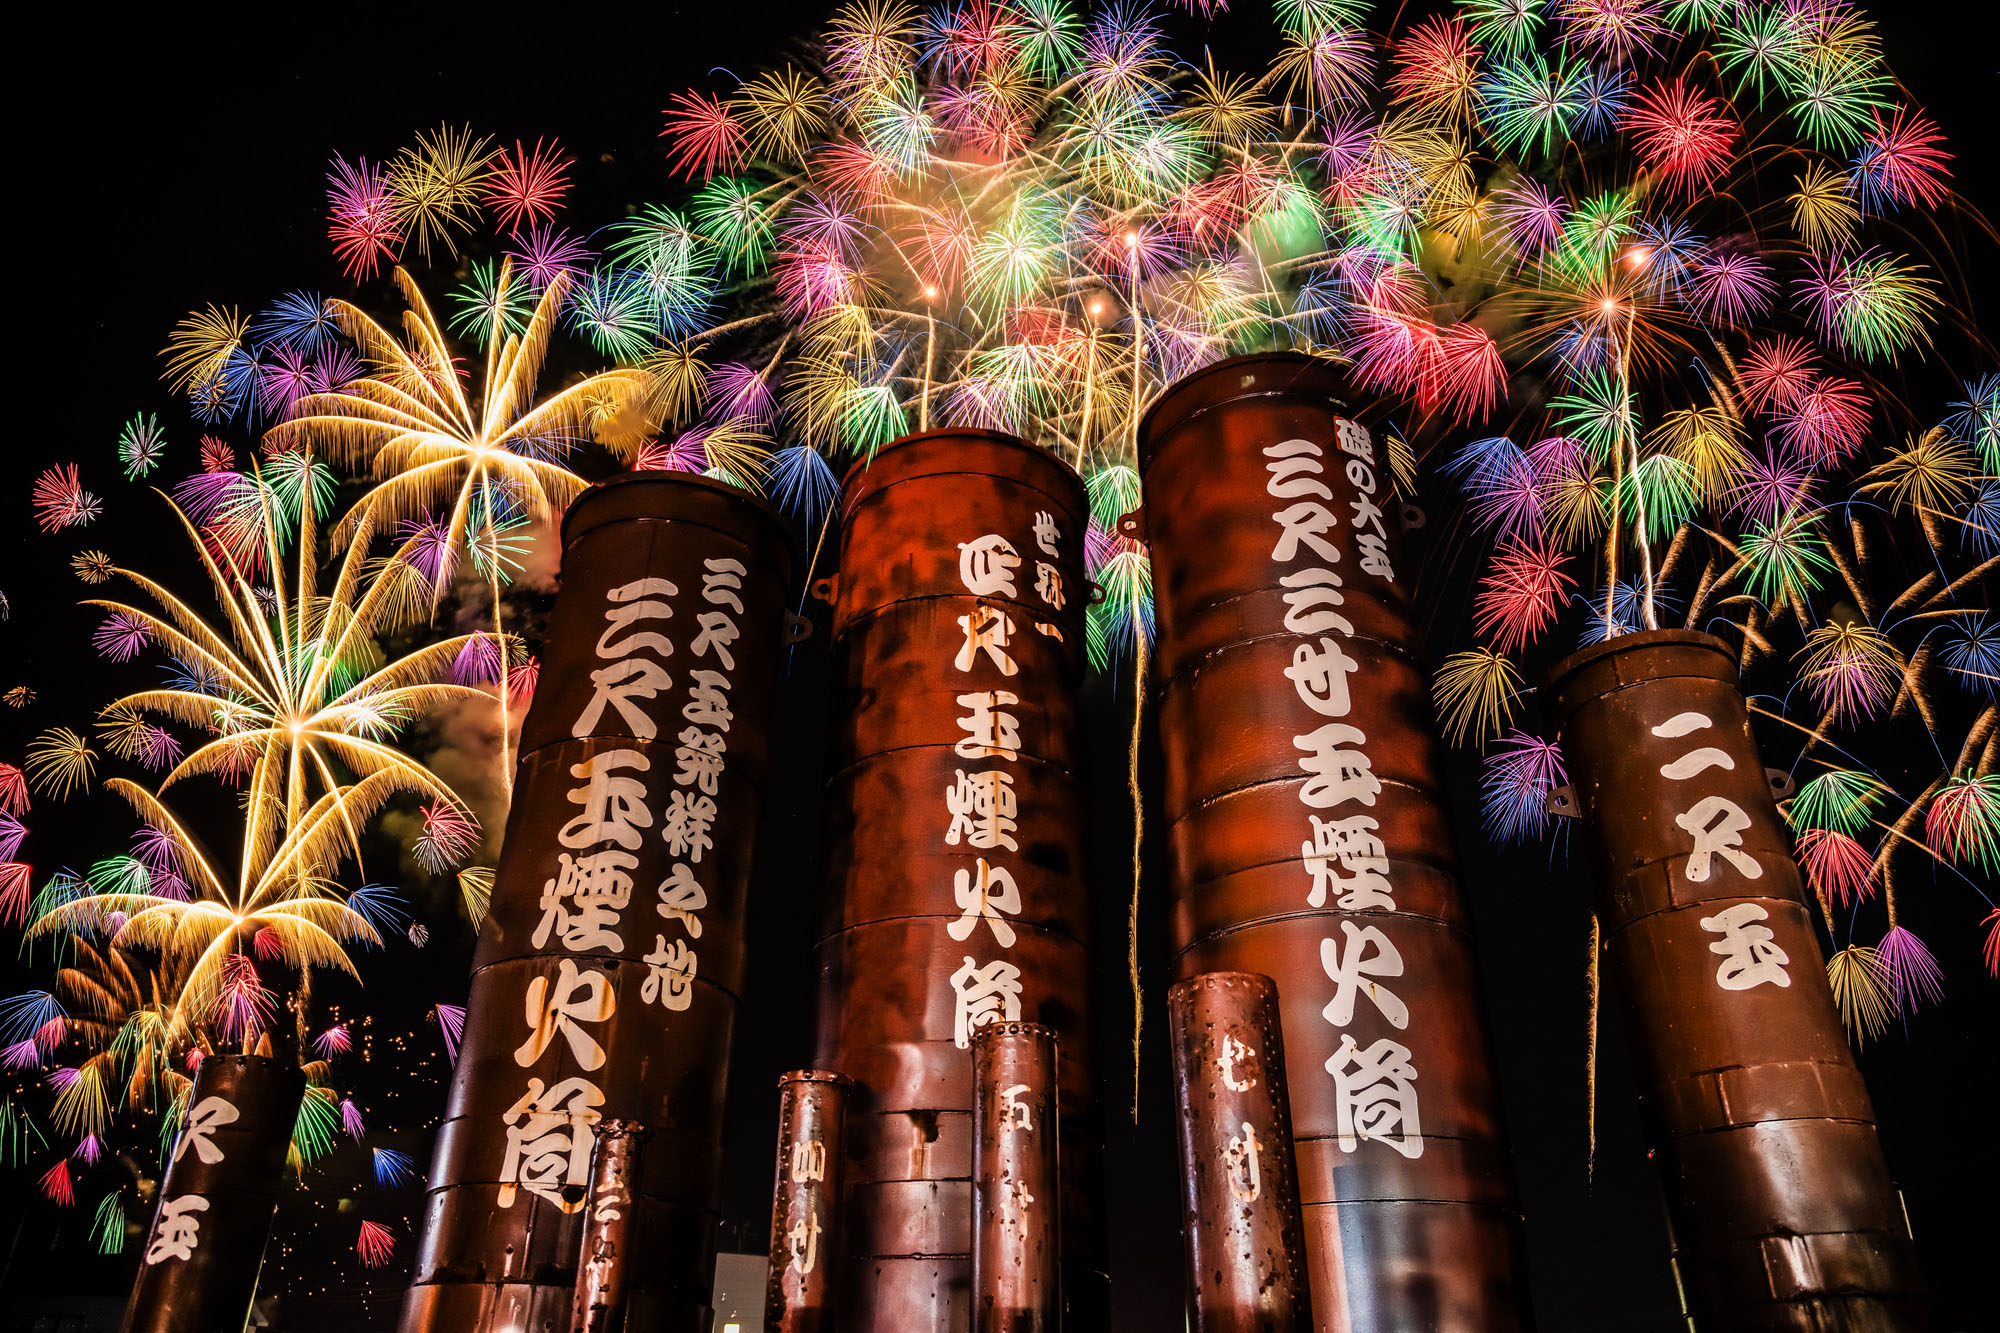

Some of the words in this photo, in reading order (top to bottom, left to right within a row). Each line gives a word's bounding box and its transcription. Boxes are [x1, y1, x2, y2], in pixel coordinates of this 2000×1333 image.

[1032, 510, 1066, 643] 世界一
[497, 577, 679, 1214] 三尺玉煙火筒
[945, 534, 1022, 1049] 四尺玉煙火筒
[1651, 712, 1791, 991] 二尺玉
[146, 1096, 240, 1266] 尺玉
